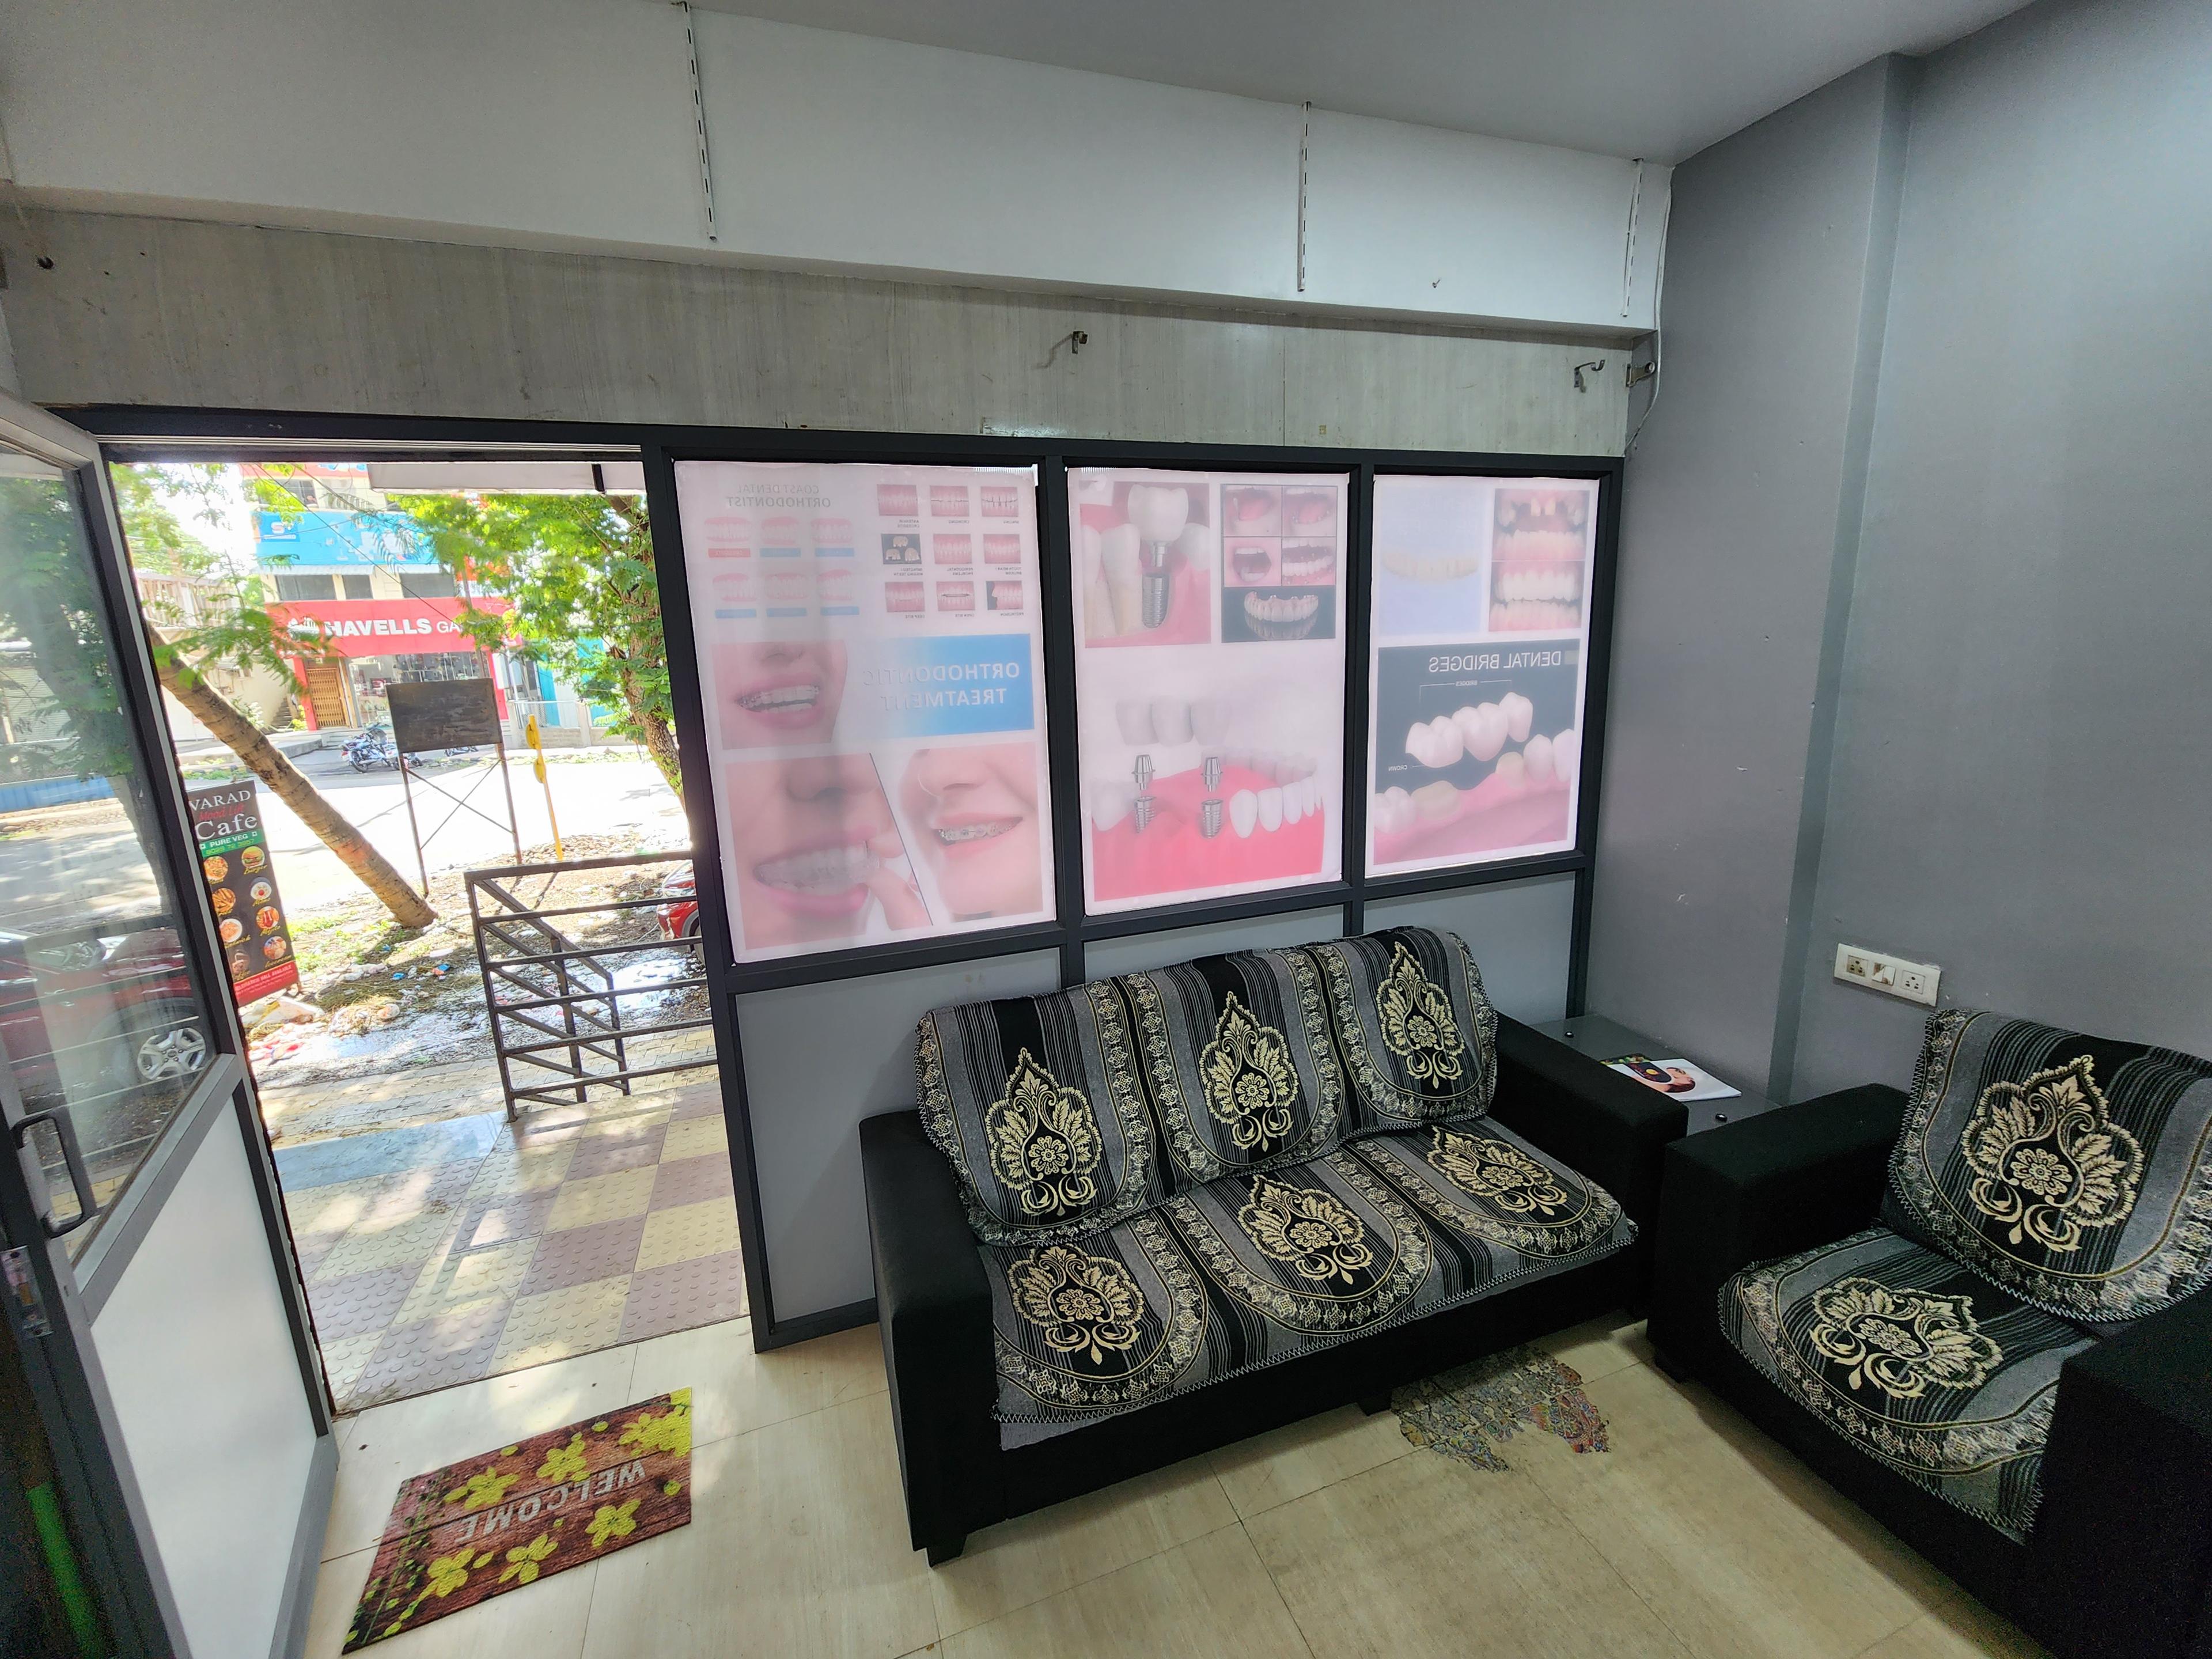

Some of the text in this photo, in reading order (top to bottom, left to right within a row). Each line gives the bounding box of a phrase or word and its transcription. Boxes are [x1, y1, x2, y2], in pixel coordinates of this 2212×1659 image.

[324, 618, 432, 637] HAVELLS
[188, 790, 251, 811] VARAD
[195, 813, 258, 840] Cafe
[210, 834, 248, 847] PURE VEG
[244, 865, 268, 874] Burger
[454, 1460, 646, 1543] WELCOME
